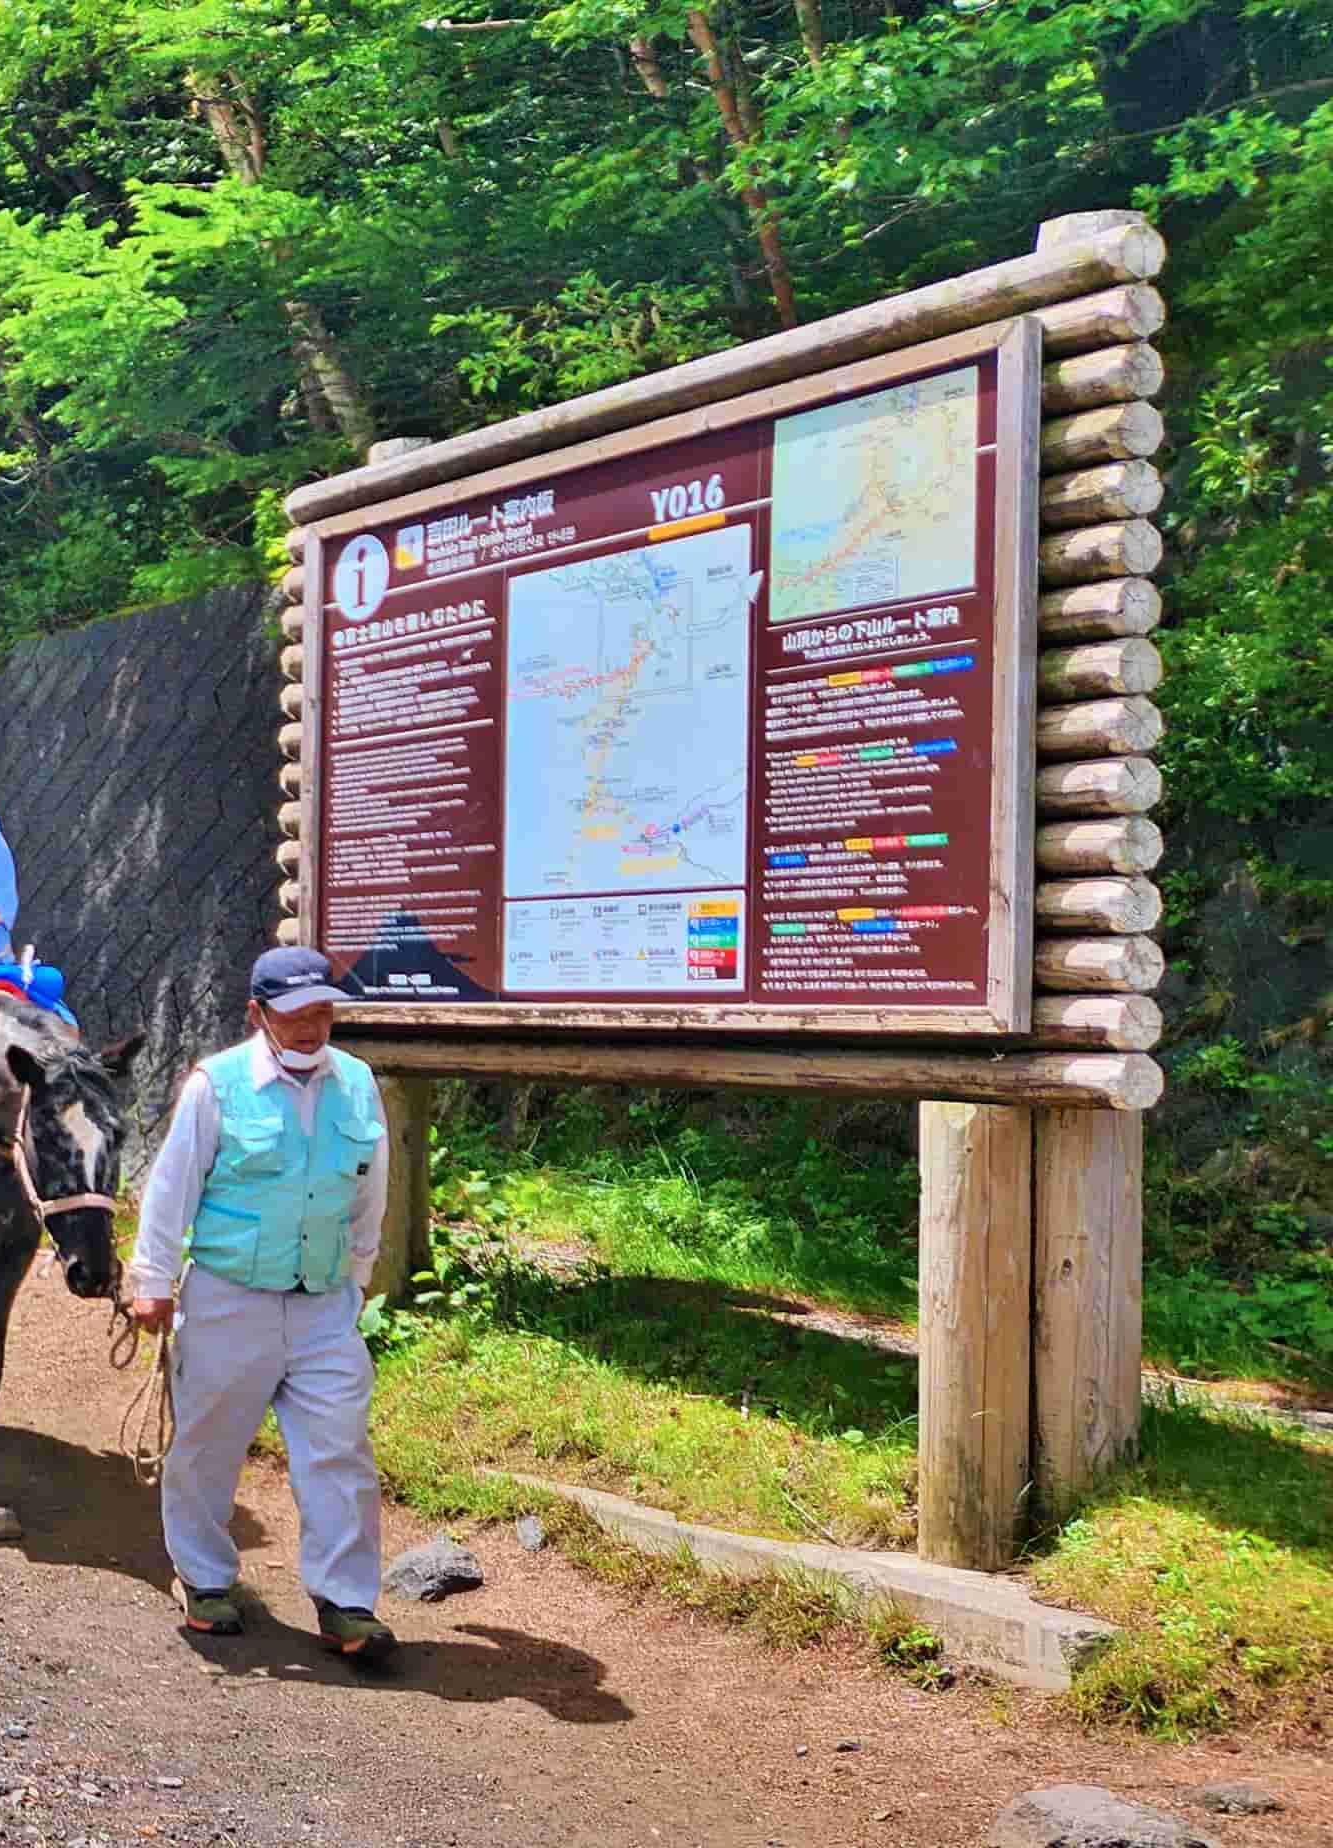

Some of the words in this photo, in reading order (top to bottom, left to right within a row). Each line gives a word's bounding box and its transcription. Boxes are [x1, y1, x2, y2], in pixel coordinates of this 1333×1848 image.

[650, 473, 725, 522] Y016
[782, 605, 960, 652] 山頂からの下山ルート案内
